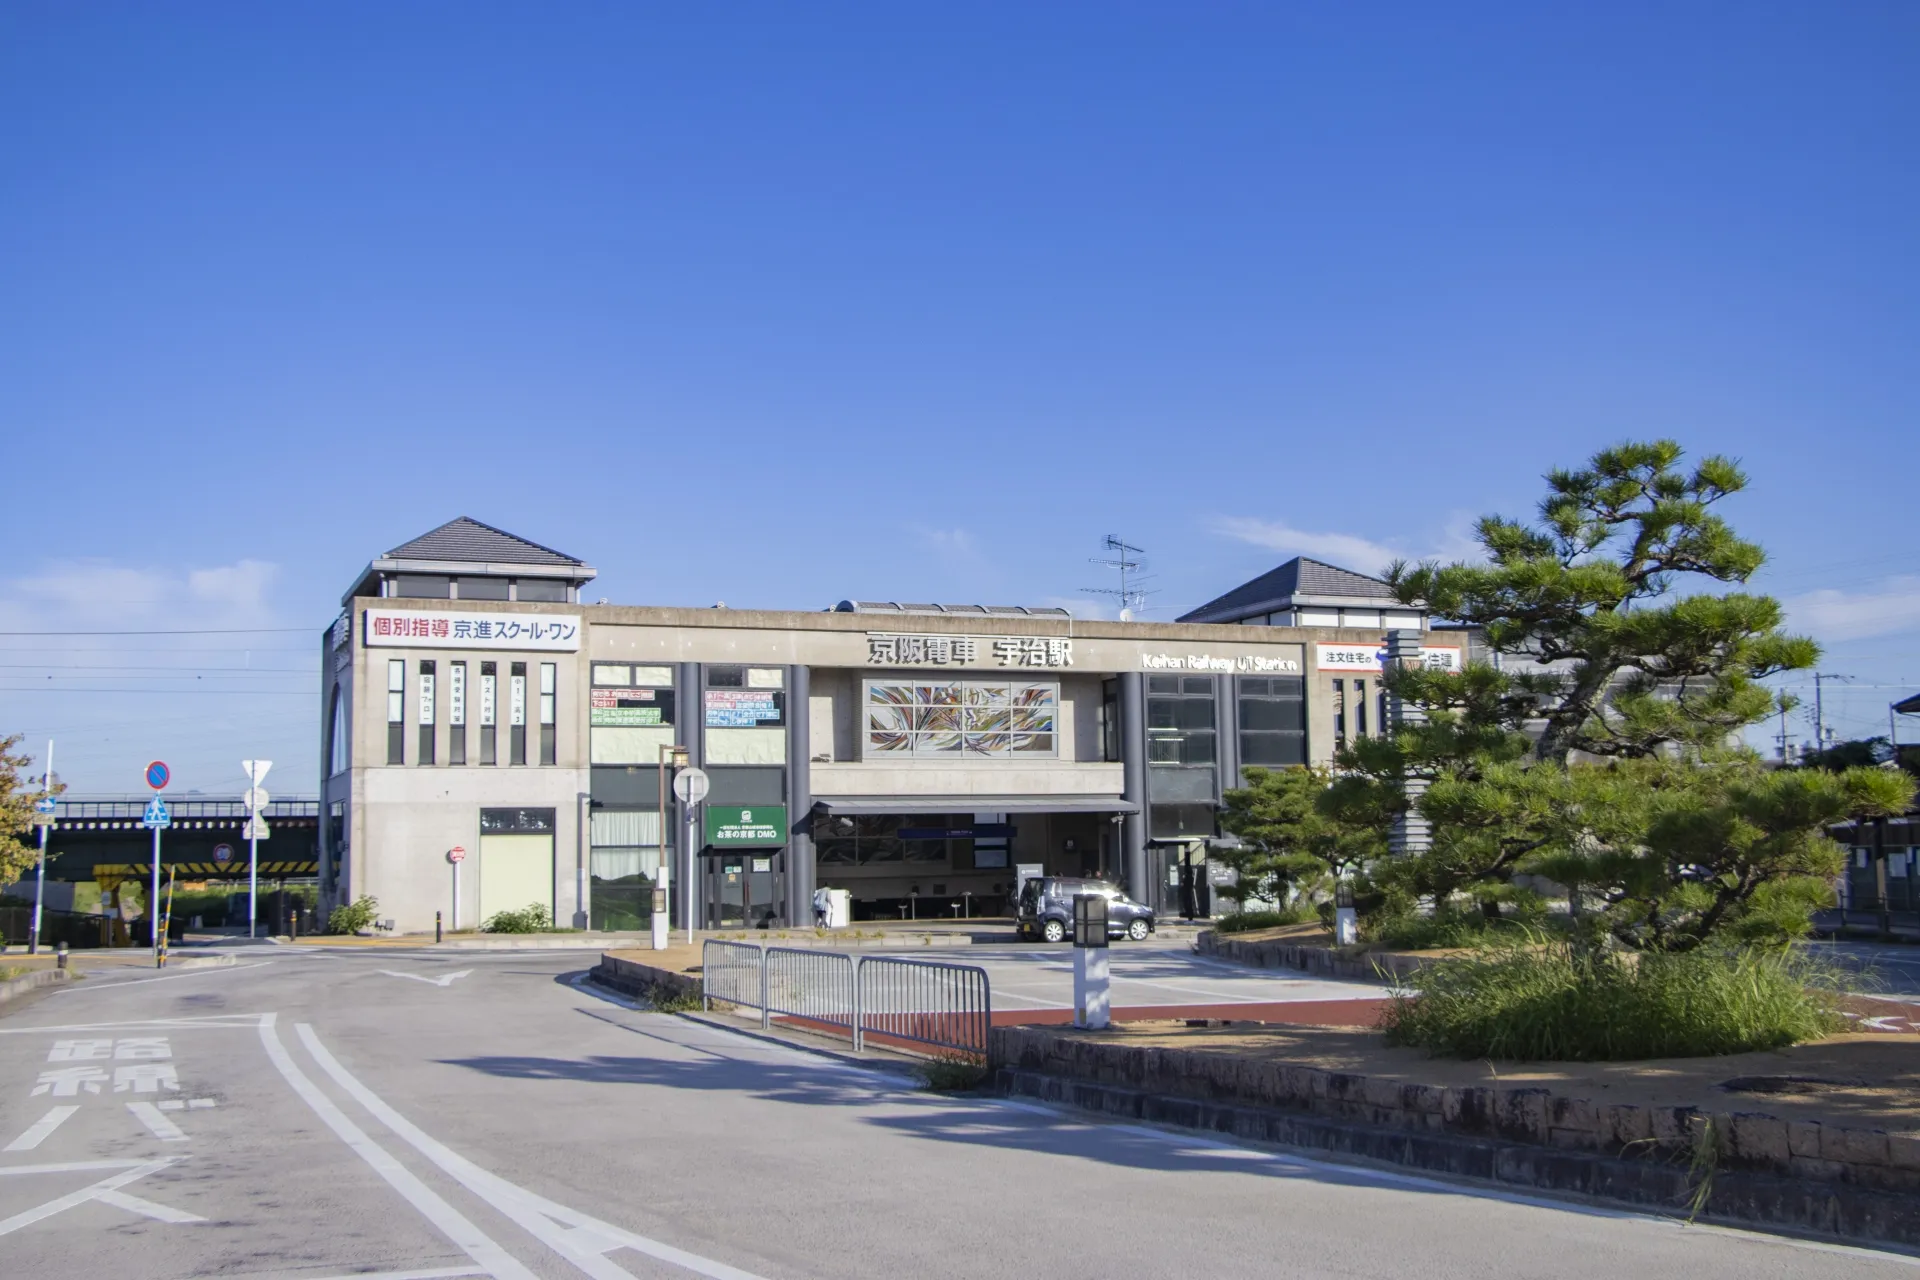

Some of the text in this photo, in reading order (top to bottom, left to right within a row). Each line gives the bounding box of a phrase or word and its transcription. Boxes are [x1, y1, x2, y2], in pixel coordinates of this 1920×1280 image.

[374, 617, 576, 640] 個別指導 京進スクール・ワン
[870, 634, 1074, 665] 京阪電車 宇治駅
[1142, 654, 1185, 669] Keihan
[1187, 655, 1235, 673] Railway
[1255, 656, 1298, 671] Station
[1326, 652, 1453, 667] 注文住宅の 住建
[717, 830, 777, 839] お茶の京都 DMO
